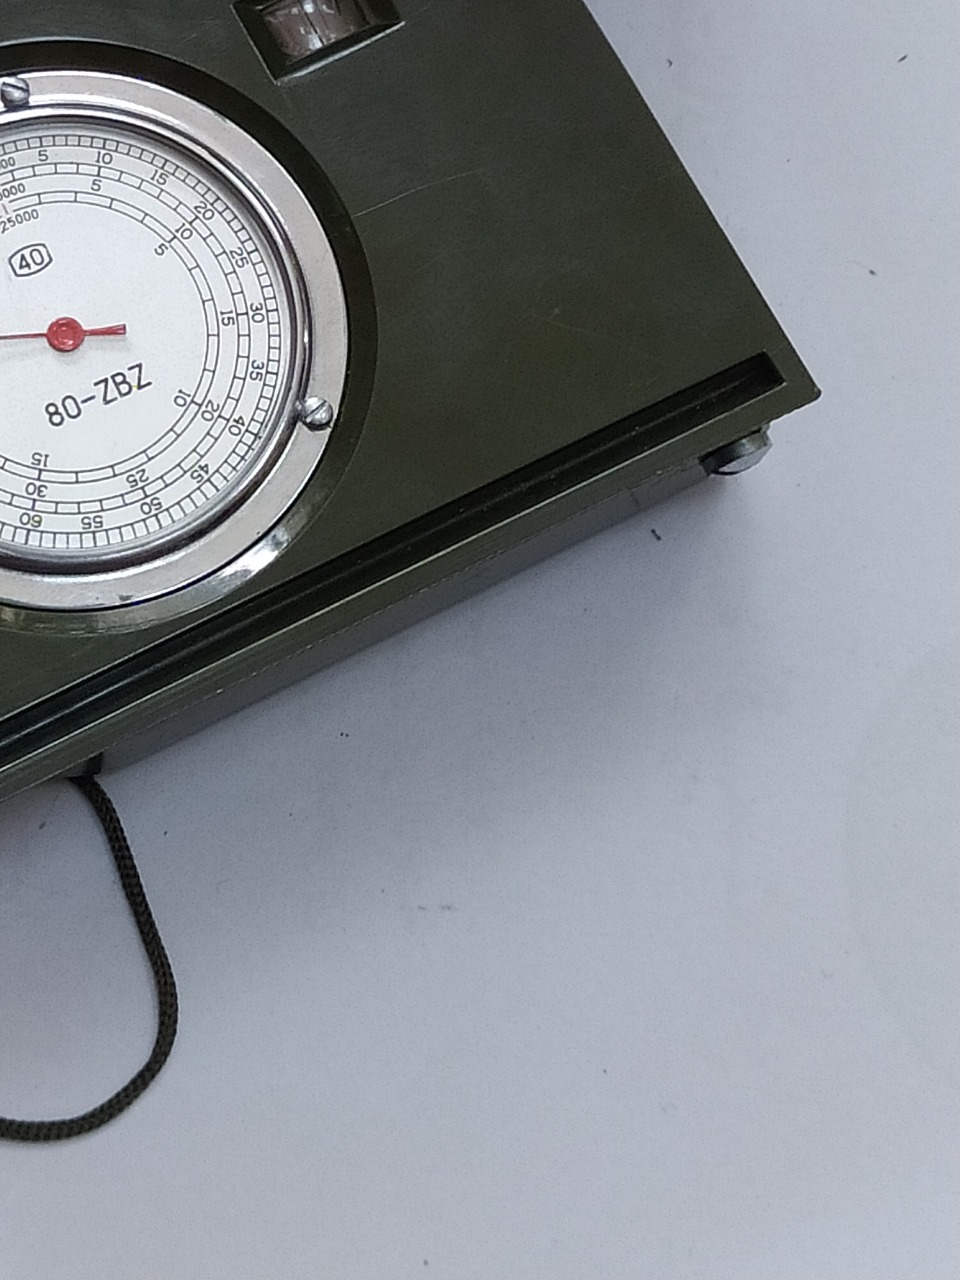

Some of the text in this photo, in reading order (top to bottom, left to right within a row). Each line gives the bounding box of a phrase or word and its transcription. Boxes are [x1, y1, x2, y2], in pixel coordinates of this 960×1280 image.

[38, 150, 48, 161] 5
[95, 152, 113, 165] 10
[90, 179, 102, 192] 5
[150, 169, 169, 186] 15
[194, 201, 215, 221] 20
[175, 222, 193, 240] 10
[154, 243, 169, 256] 5
[230, 246, 250, 269] 25
[18, 248, 44, 273] 40
[219, 309, 235, 327] 15
[250, 302, 265, 323] 30
[249, 359, 265, 382] 35
[44, 362, 153, 426] 80-ZBZ
[173, 388, 191, 408] 10
[201, 399, 220, 422] 20
[228, 415, 246, 437] 40
[31, 452, 50, 468] 15
[126, 468, 149, 488] 25
[190, 463, 209, 483] 45
[25, 482, 48, 498] 30
[140, 496, 163, 515] 50
[19, 512, 43, 528] 60
[81, 515, 103, 530] 55
